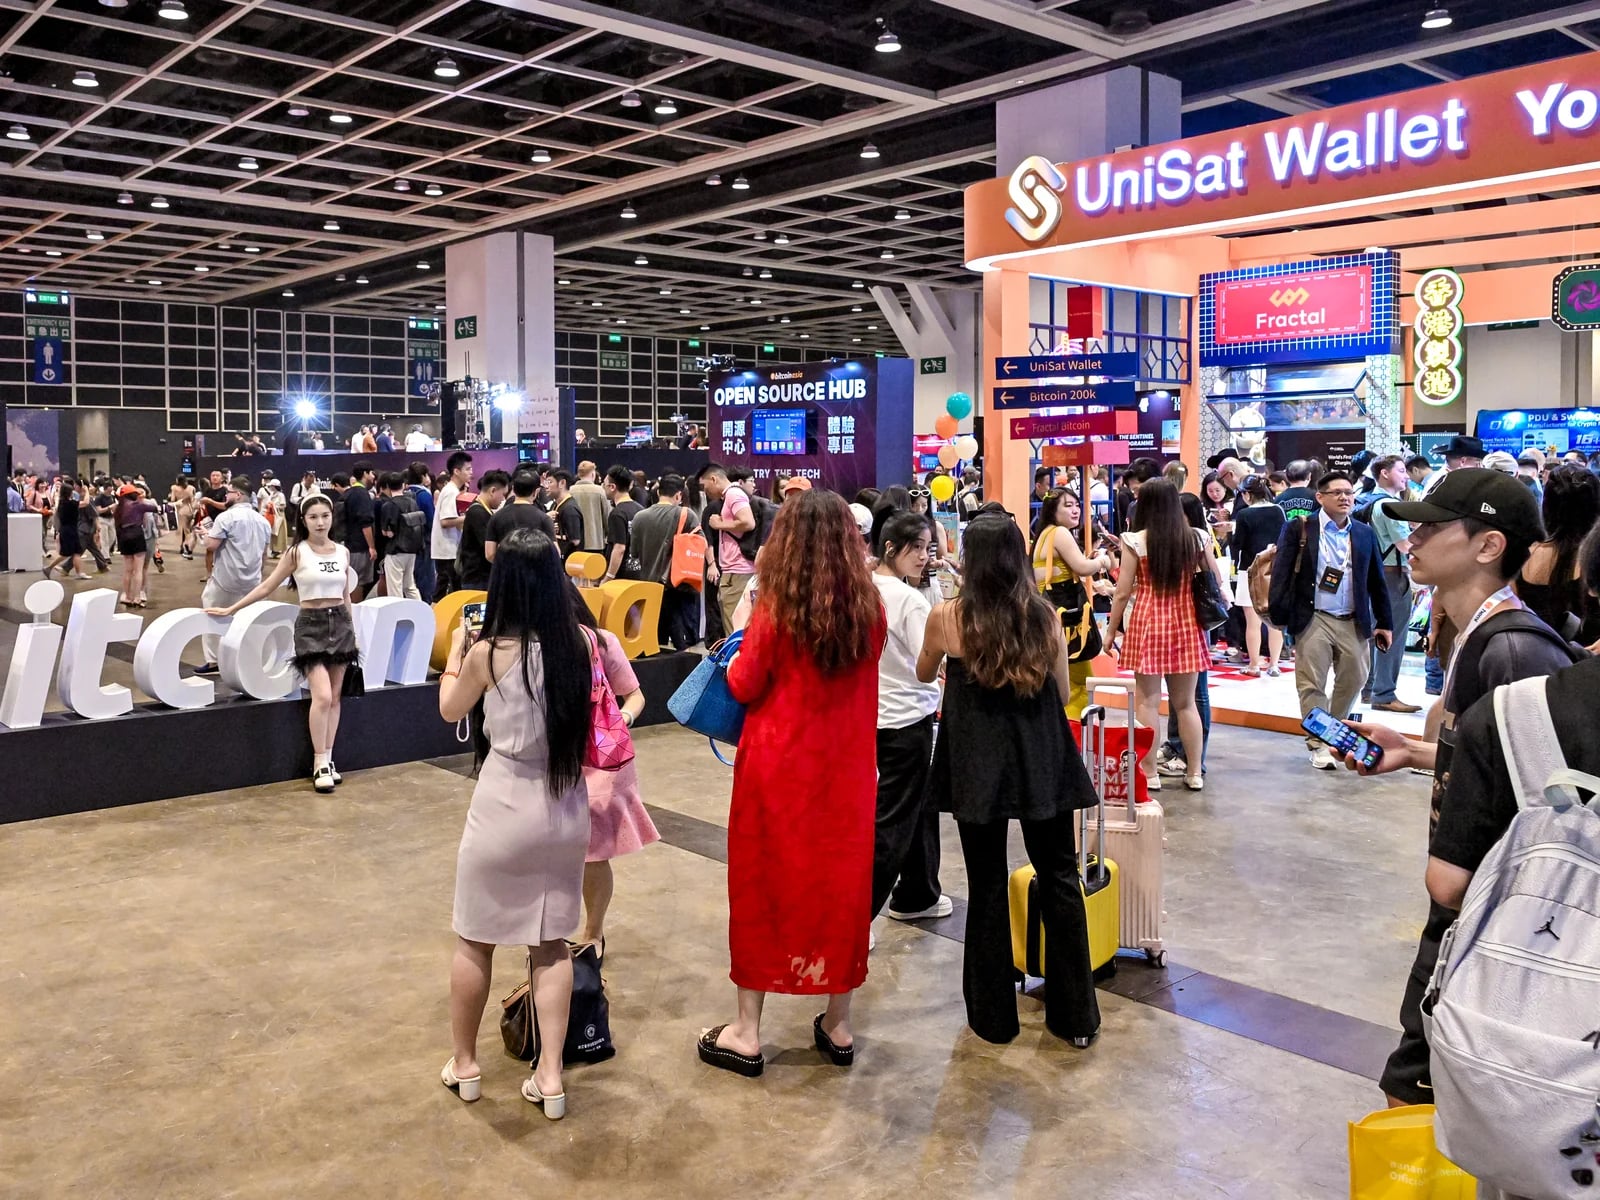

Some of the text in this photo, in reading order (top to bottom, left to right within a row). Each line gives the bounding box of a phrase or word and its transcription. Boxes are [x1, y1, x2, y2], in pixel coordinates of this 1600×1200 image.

[1076, 98, 1468, 212] UniSat Wallet
[1256, 307, 1326, 329] Fractal
[1423, 276, 1455, 396] 香港製造
[1029, 359, 1102, 372] UniSat Wallet
[714, 378, 866, 406] OPEN SOURCE HUB
[1030, 389, 1096, 402] Bitcoin 200k
[827, 415, 855, 435] 體驗
[1032, 420, 1090, 433] Fractal Bitcoin
[1528, 414, 1549, 422] PDU
[722, 420, 746, 437] 開源
[722, 438, 746, 455] 中心
[827, 435, 855, 454] 專區
[753, 469, 770, 479] TRY
[795, 469, 820, 479] TECH
